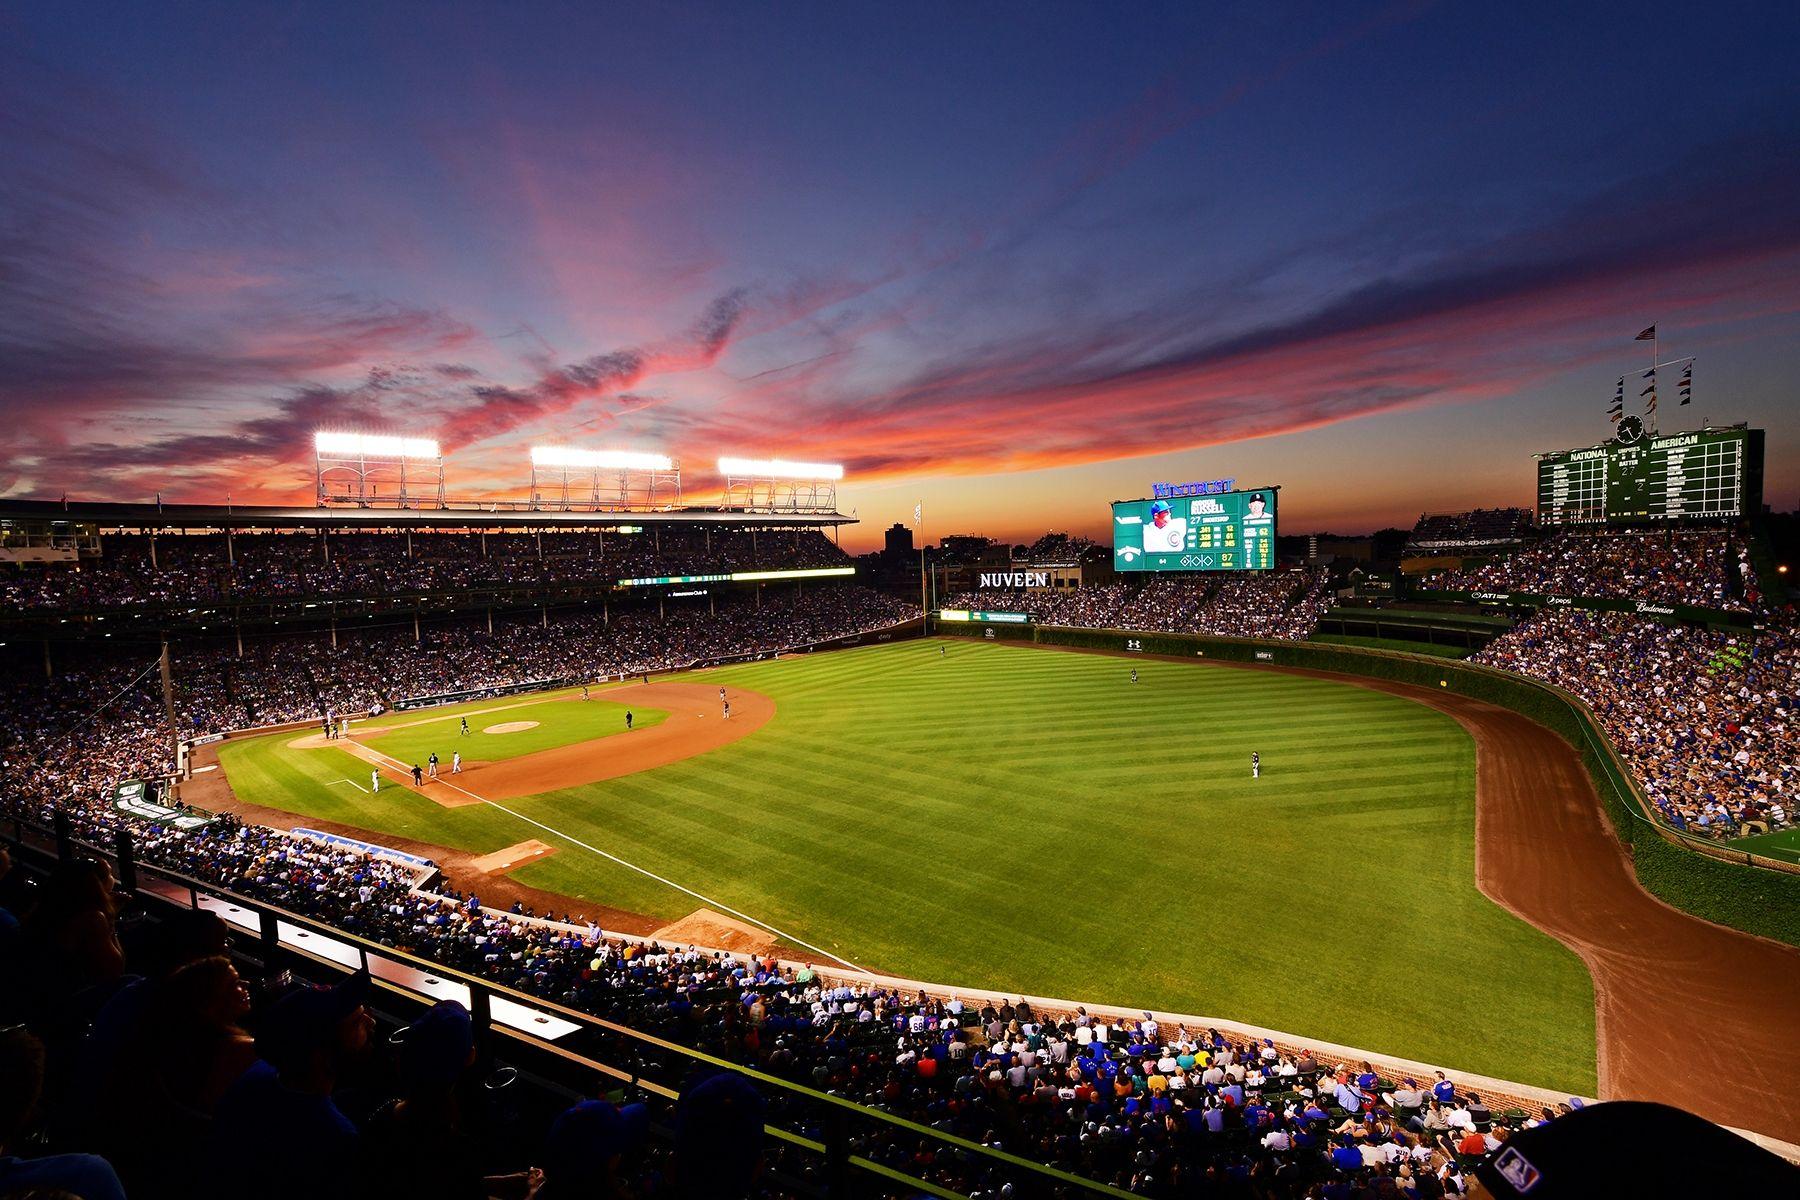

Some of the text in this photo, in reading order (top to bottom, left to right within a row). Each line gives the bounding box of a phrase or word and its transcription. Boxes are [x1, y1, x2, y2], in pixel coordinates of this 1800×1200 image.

[1651, 435, 1698, 450] AMERICAN
[1570, 449, 1608, 461] NATIONAL
[1621, 466, 1635, 476] 27
[1152, 479, 1235, 497] WINTRUST
[1637, 483, 1643, 491] 2
[1190, 516, 1201, 524] 27
[980, 572, 1048, 588] NUVEEN
[1635, 601, 1674, 614] Budweiser
[914, 1022, 923, 1031] 68
[954, 1049, 963, 1057] 10
